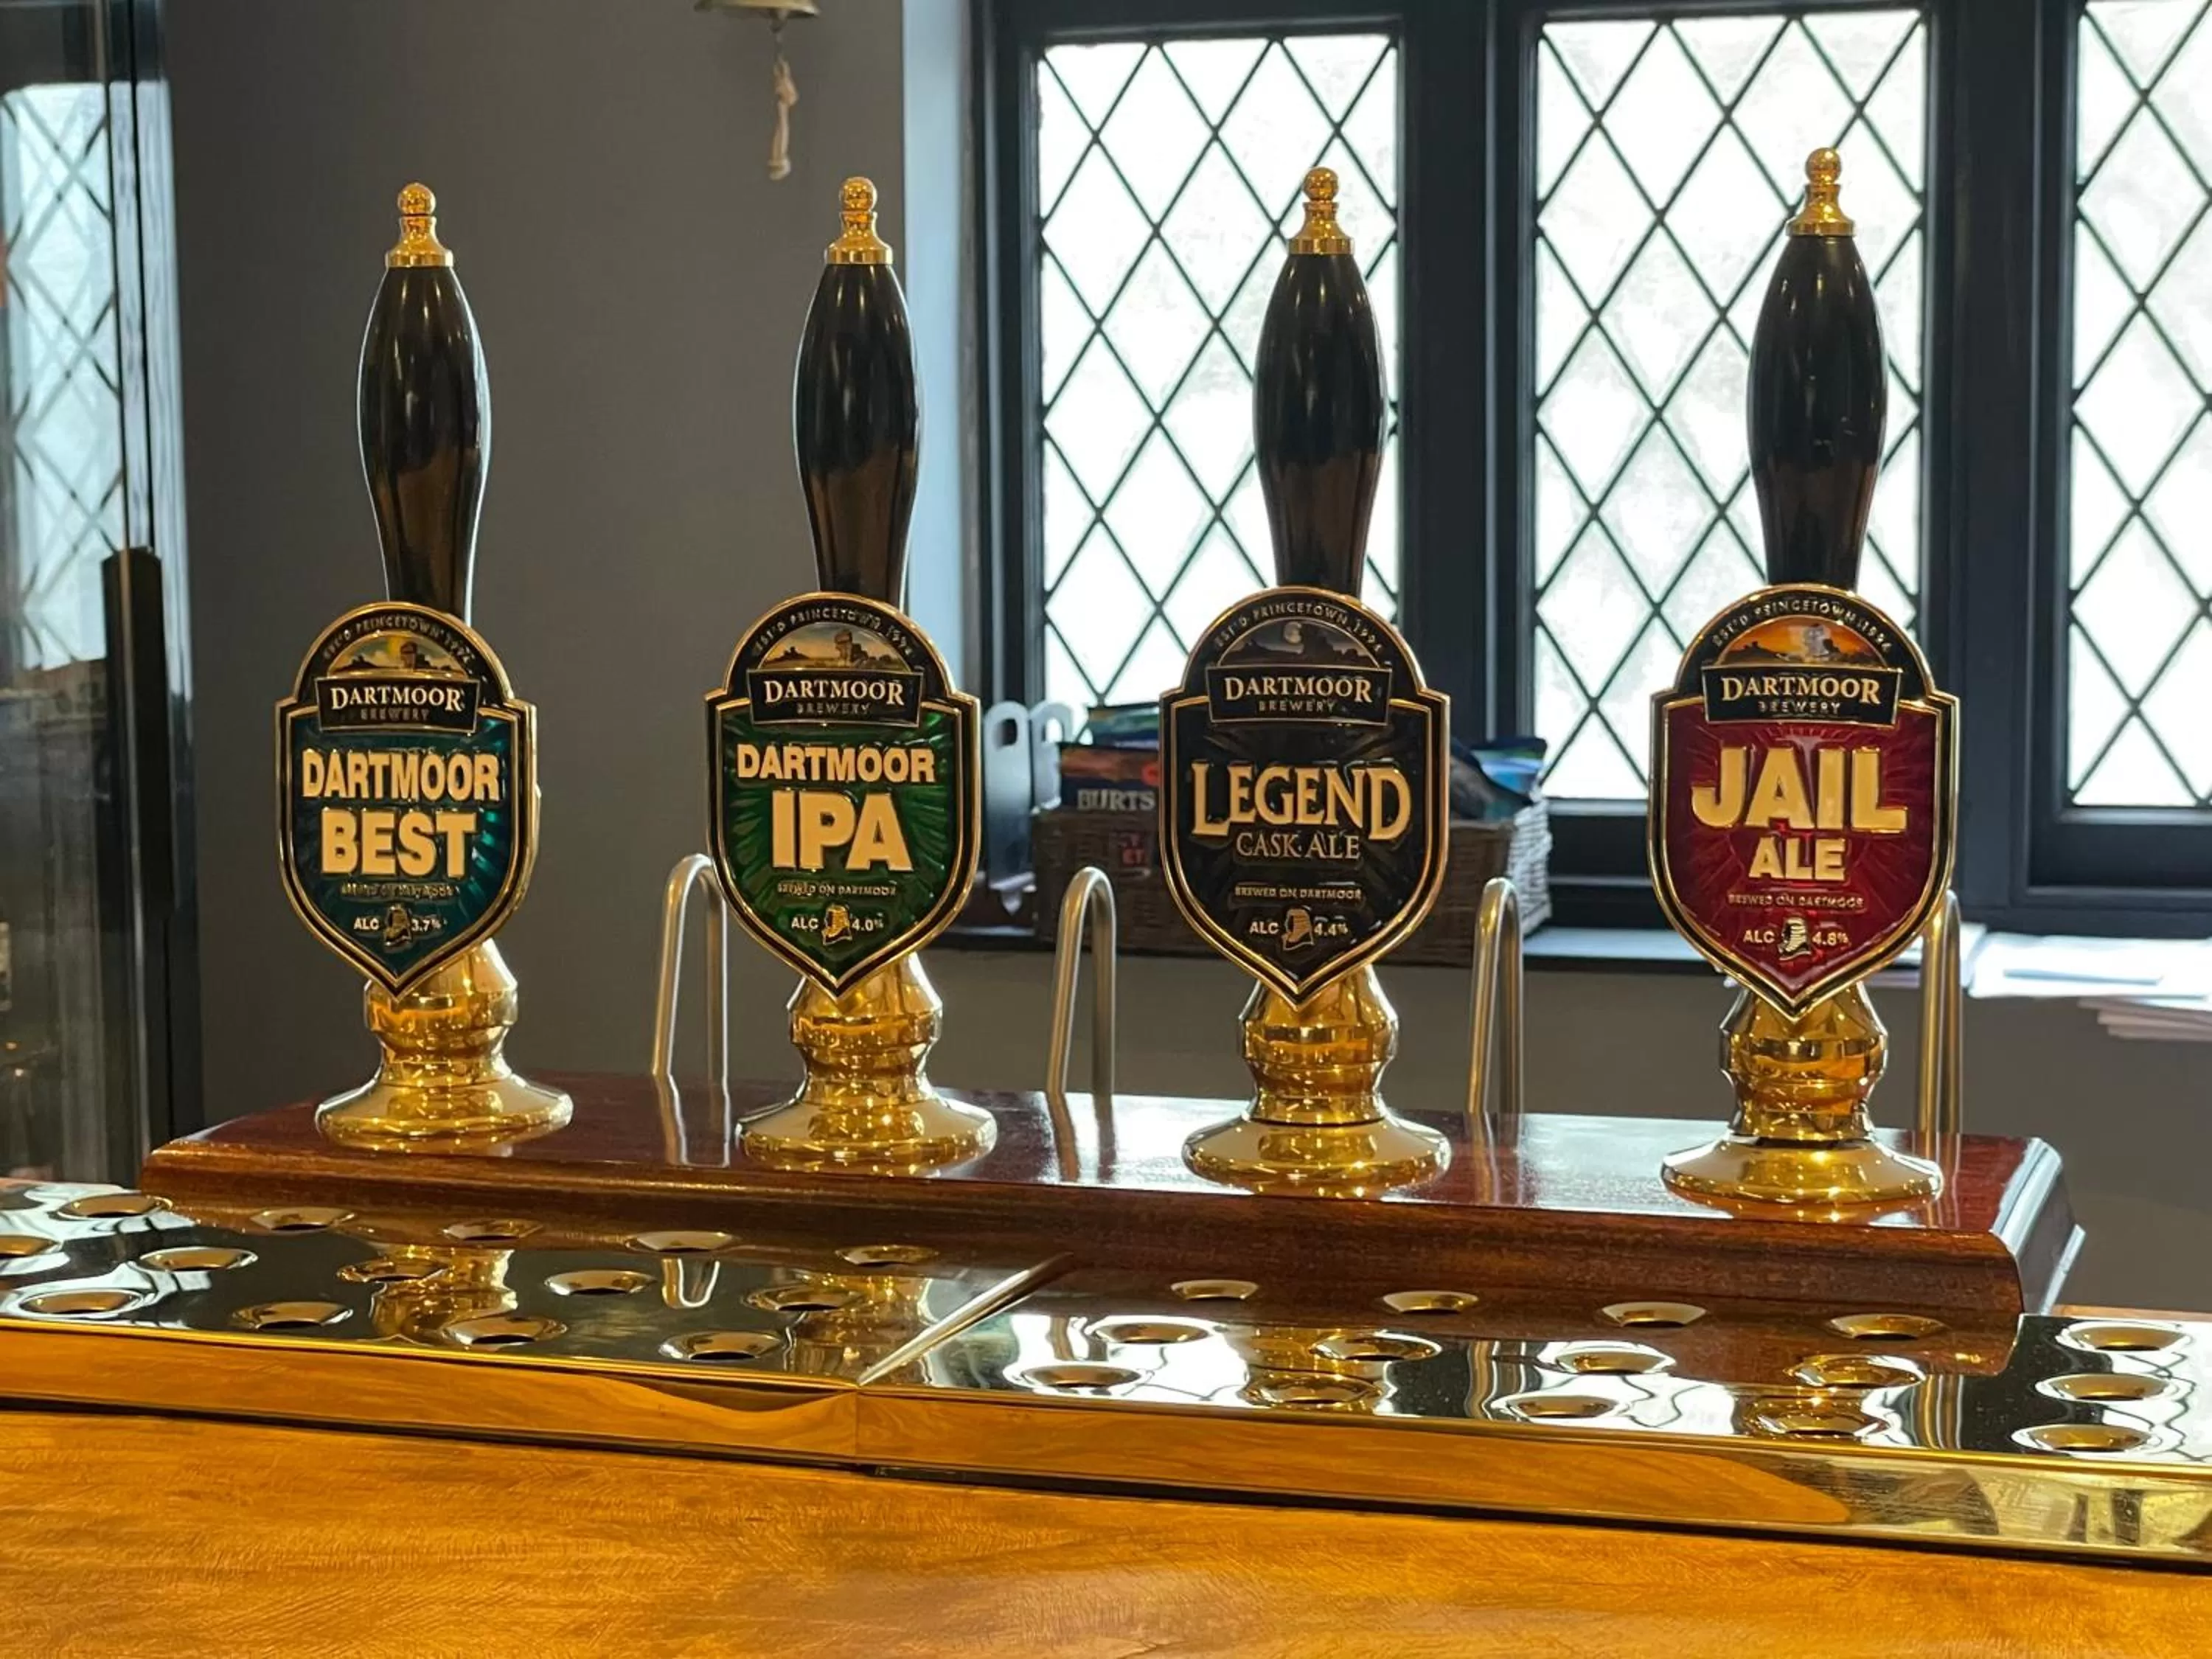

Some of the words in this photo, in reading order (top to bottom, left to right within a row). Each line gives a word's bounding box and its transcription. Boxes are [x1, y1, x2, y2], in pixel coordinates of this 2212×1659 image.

[1253, 602, 1348, 625] PRINCETOWN
[1754, 601, 1856, 623] PRINCETOWN
[330, 686, 462, 712] DARTMOOR
[764, 680, 904, 706] DARTMOOR
[1224, 677, 1372, 703] DARTMOOR
[1721, 677, 1881, 705] DARTMOOR
[361, 707, 430, 720] BREWERY
[796, 703, 871, 714] BREWERY
[1259, 699, 1336, 712] BREWERY
[1759, 700, 1841, 714] BREWERY
[737, 743, 936, 783] DARTMOOR
[302, 748, 501, 801] DARTMOOR
[1077, 788, 1156, 810] BURTS
[1691, 746, 1907, 834] JAIL
[1191, 763, 1411, 840] LEGEND
[321, 807, 477, 877] BEST
[772, 790, 914, 872] IPA
[1236, 832, 1299, 858] CASK
[1305, 834, 1360, 860] ALE
[1748, 836, 1846, 880] ALE
[818, 884, 835, 894] ON
[838, 886, 897, 896] DARTMOOR
[1234, 887, 1277, 897] BREWED
[1279, 888, 1297, 898] ON
[1300, 888, 1362, 900] DARTMOOR
[1775, 895, 1795, 906] ON
[1798, 896, 1864, 908] DARTMOOR
[353, 917, 380, 931] ALC
[791, 916, 818, 930] ALC
[1249, 921, 1279, 934] ALC
[1742, 930, 1775, 943] ALC
[1812, 931, 1850, 946] 4.8%
